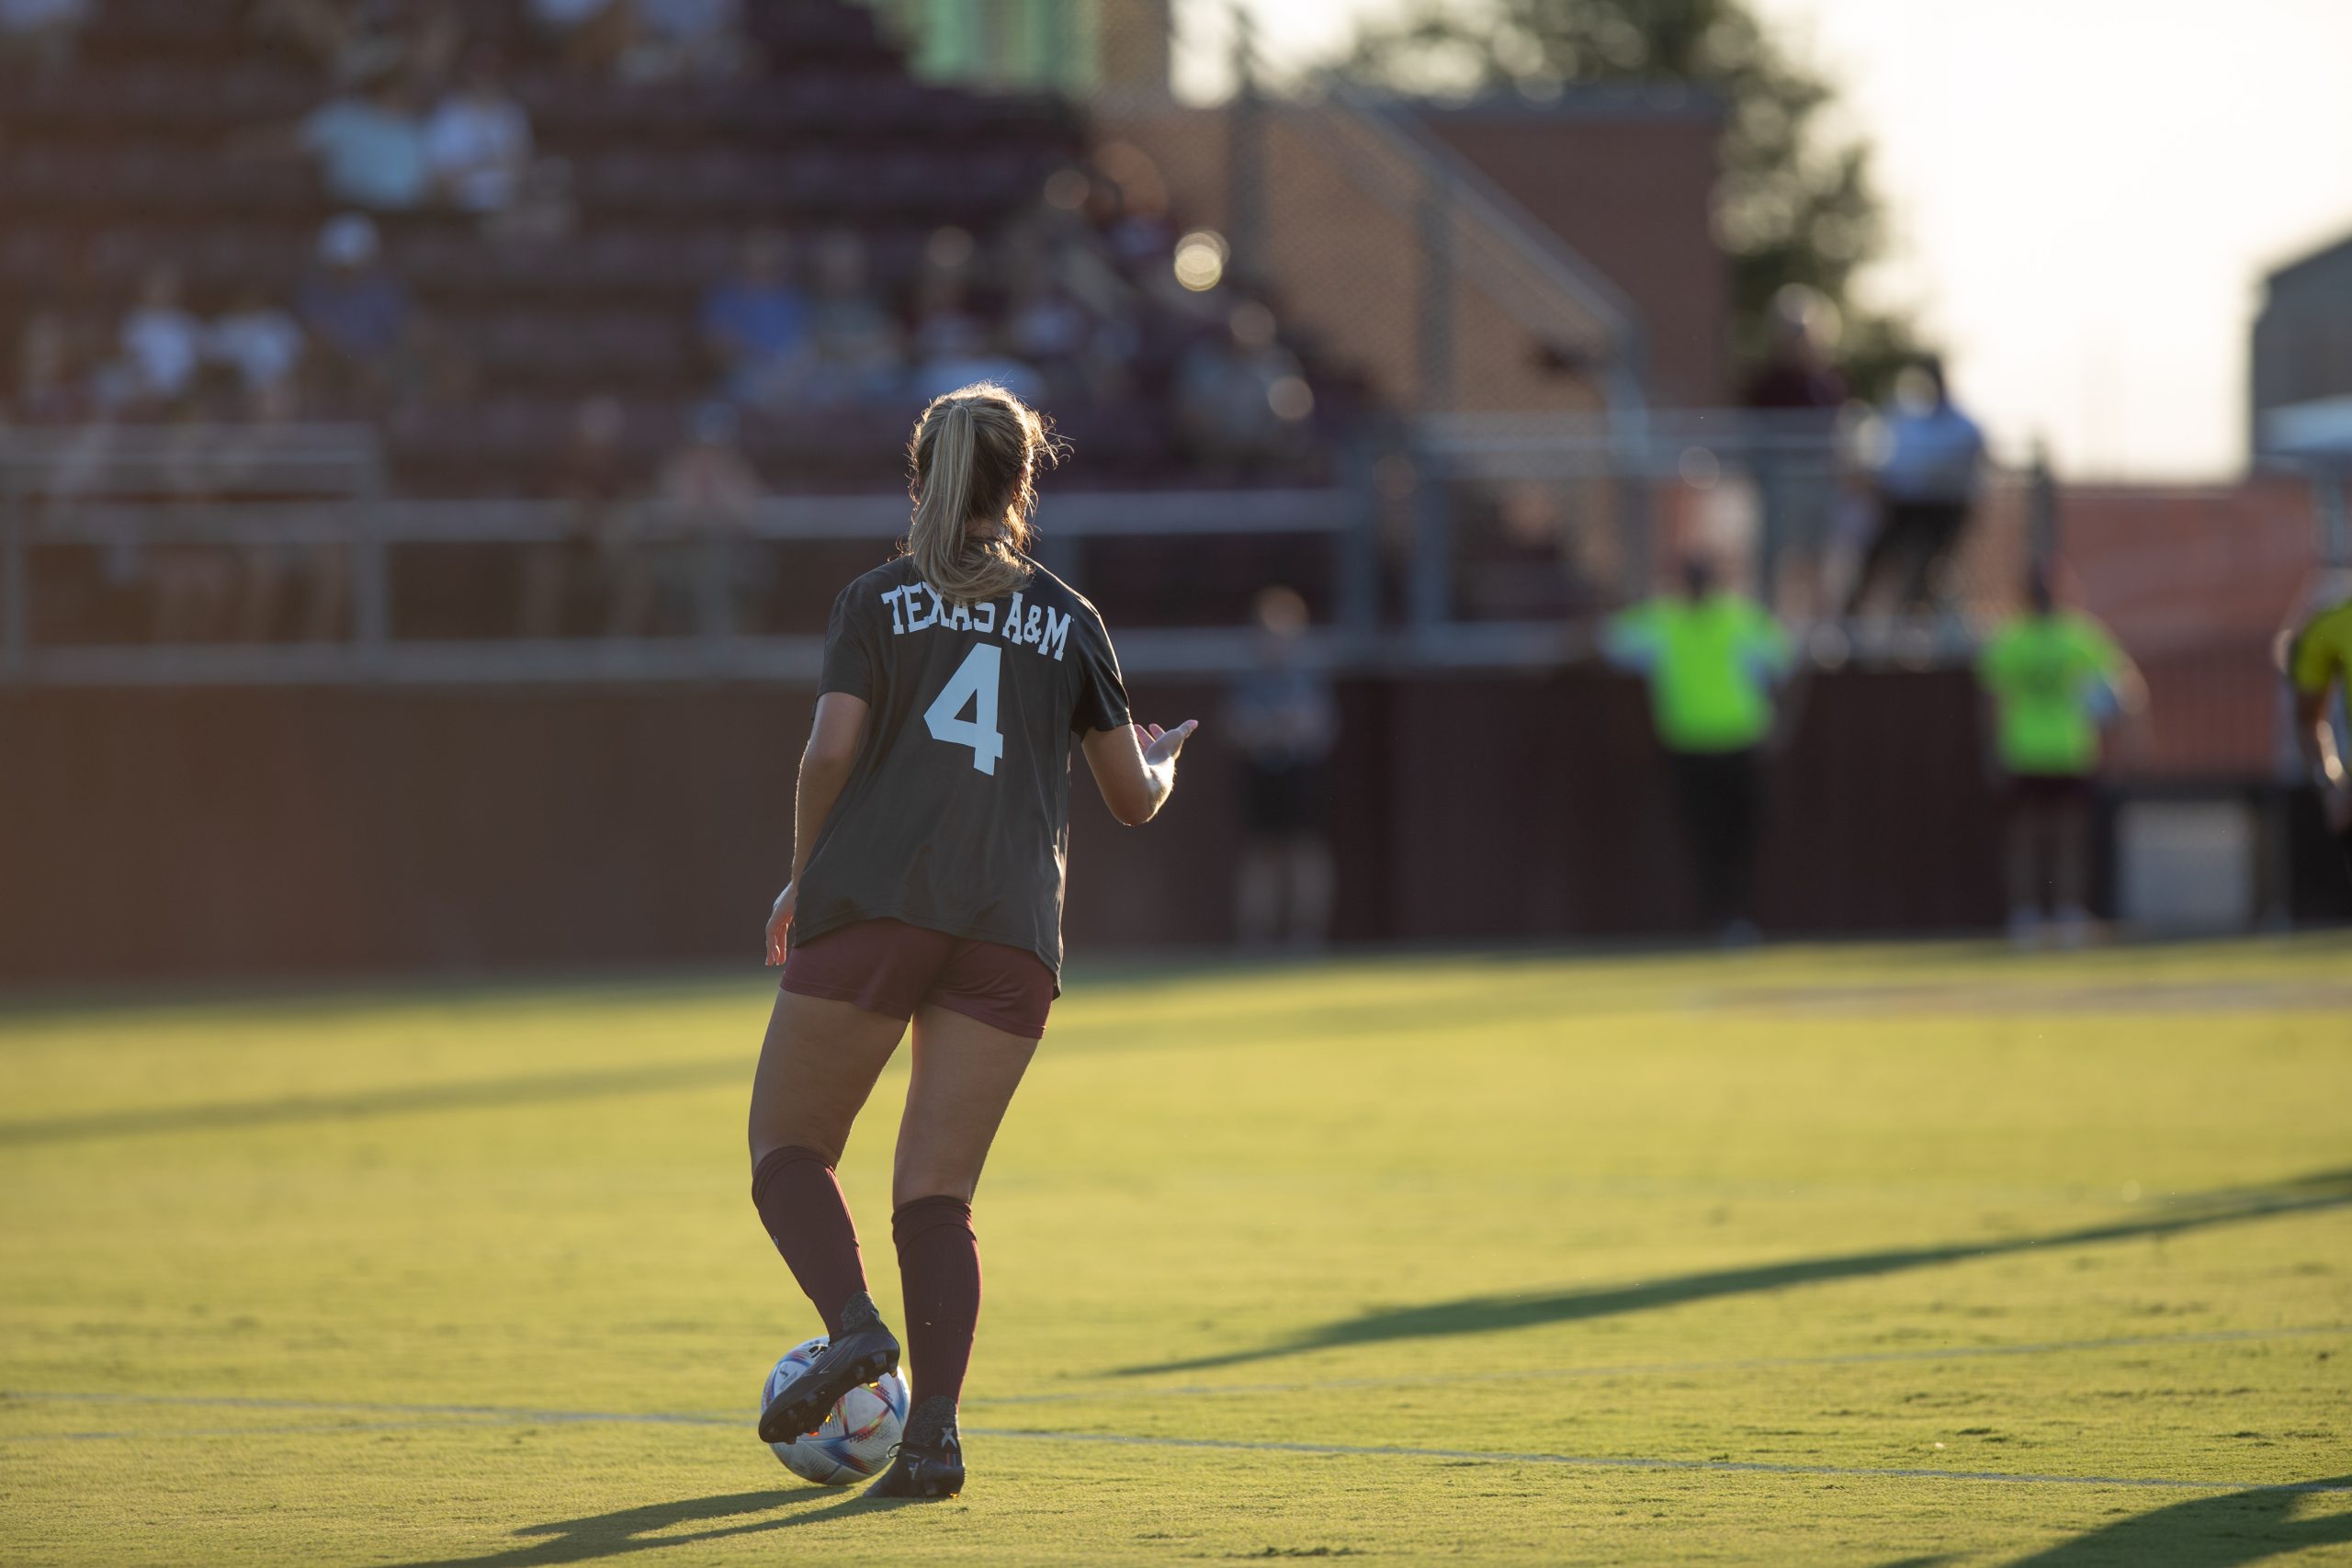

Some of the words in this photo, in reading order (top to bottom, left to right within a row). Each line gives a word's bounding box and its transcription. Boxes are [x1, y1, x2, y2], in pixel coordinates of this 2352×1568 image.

[880, 581, 996, 635] TEXAS
[1001, 591, 1072, 661] A&M
[923, 642, 1003, 775] 4
